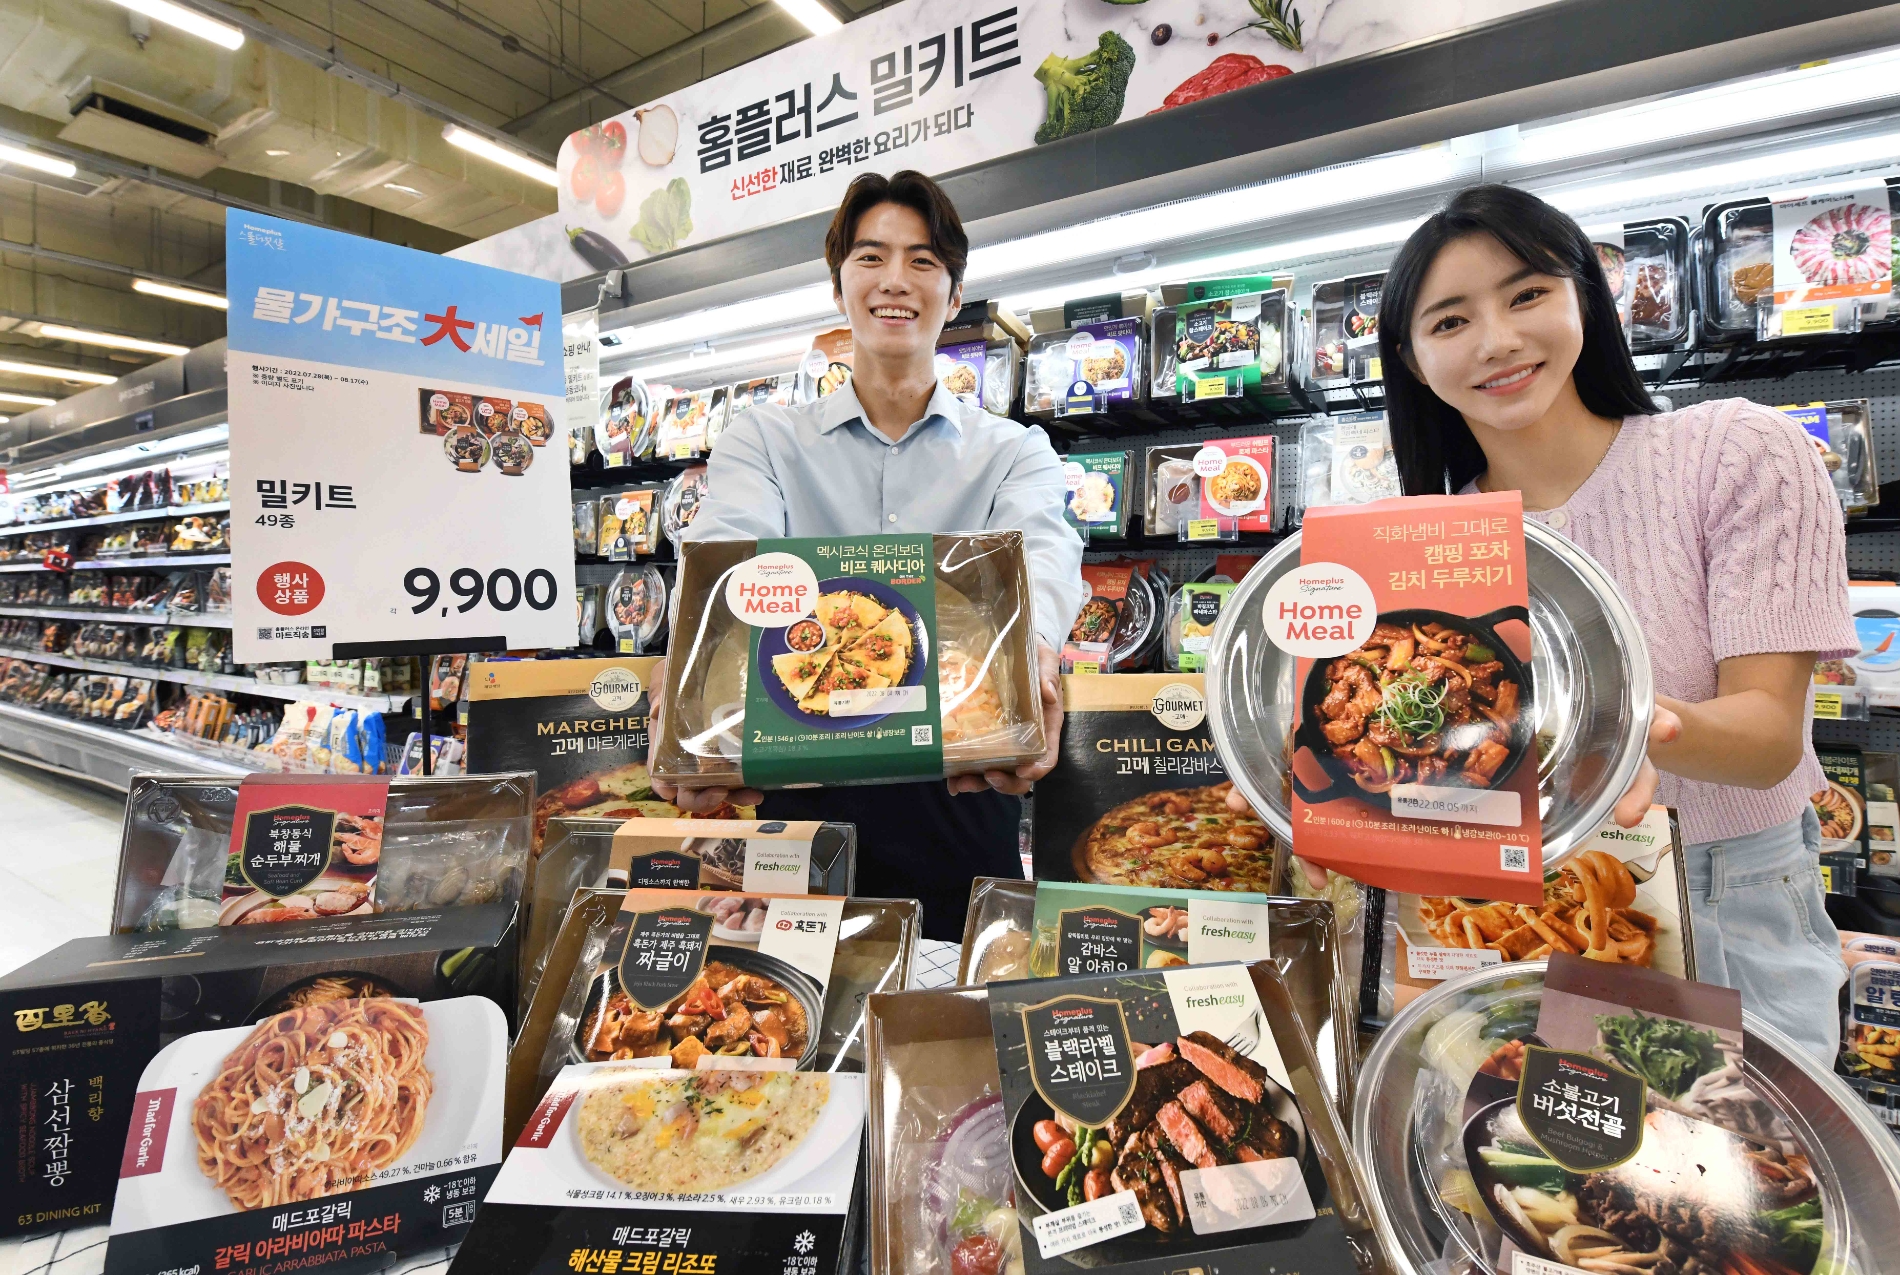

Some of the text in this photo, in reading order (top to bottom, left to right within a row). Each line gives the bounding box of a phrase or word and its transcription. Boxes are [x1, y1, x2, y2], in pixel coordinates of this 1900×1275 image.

[696, 6, 1021, 174] 홈플러스 밀키트
[730, 104, 973, 200] 신선한 완벽한 요리가 되다
[244, 223, 282, 236] Homeplus
[256, 479, 356, 510] 밀키트
[255, 514, 296, 528] 49종
[1373, 517, 1510, 543] 직화냄비 그대로
[817, 543, 924, 558] 멕시코식 온더보더
[1424, 540, 1511, 564] 캠핑 포차
[840, 559, 926, 575] 비프 퀘사디아
[274, 573, 309, 589] 행사
[1299, 577, 1344, 585] Homeplus
[1388, 565, 1512, 591] 김치 두루치기
[274, 589, 309, 605] 상품
[403, 567, 558, 617] 9,900
[739, 582, 808, 597] Home
[1300, 583, 1344, 595] Signature
[744, 597, 801, 614] Meal
[1279, 601, 1362, 620] Home
[275, 631, 310, 640] 마트직송
[1286, 621, 1355, 641] Meal
[591, 682, 640, 697] GOURMET
[1153, 698, 1203, 714] GOURMET
[753, 730, 773, 743] 2인분
[819, 732, 831, 741] 조리
[835, 732, 847, 740] 조리
[848, 731, 865, 739] 난이도
[551, 736, 584, 756] 고메
[1096, 738, 1160, 753] CHILI
[1116, 757, 1224, 775] 고메 칠리감바스
[1303, 809, 1439, 835] 2인분 600 10분 조리 조리 난이도
[269, 828, 313, 840] 북창동식
[273, 840, 302, 853] 해물
[250, 852, 321, 868] 순두부찌개
[754, 861, 801, 875] fresheasy
[638, 878, 671, 886] 디핑소스까지
[1083, 915, 1118, 925] Homeplus
[1202, 914, 1240, 924] Collaboration
[1201, 925, 1256, 943] fresheasy
[633, 938, 657, 949] 흑돈가
[660, 940, 676, 950] 제주
[1081, 942, 1118, 958] 감바스
[636, 950, 690, 972] 짜글이
[1067, 957, 1082, 974] 알
[1183, 983, 1224, 992] Collaboration
[1186, 993, 1245, 1009] fresheasy
[1052, 1007, 1093, 1018] Homeplus
[1043, 1027, 1081, 1038] 스테이크부터
[1096, 1024, 1109, 1032] 있는
[1044, 1035, 1117, 1062] 블랙라벨
[1050, 1058, 1122, 1083] 스테이크
[1558, 1058, 1608, 1078] Homeplus
[1558, 1063, 1608, 1082] Signature
[88, 1075, 104, 1122] 백리향
[1542, 1078, 1619, 1114] 소불고기
[1533, 1094, 1626, 1139] 버섯전골
[43, 1078, 75, 1187] 삼선짬뽕
[531, 1117, 550, 1142] Garlic
[1540, 1133, 1580, 1153] Mushroom
[1547, 1127, 1598, 1150] Beef Bulgogi
[379, 1168, 401, 1179] 49.27
[413, 1162, 436, 1174] 건마늘
[436, 1158, 453, 1169] 0.66
[462, 1154, 477, 1164] 함유
[446, 1186, 476, 1199] 냉동 보관
[566, 1190, 604, 1200] 식물성크림
[658, 1192, 665, 1200] 3
[677, 1193, 701, 1203] 위소라
[702, 1194, 715, 1203] 2.5
[729, 1195, 745, 1205] 새우
[746, 1195, 765, 1205] 2.93
[778, 1195, 802, 1205] 유크림
[803, 1196, 822, 1205] 0.18
[18, 1203, 102, 1226] 63 DINING KIT
[272, 1201, 352, 1232] 매드포갈릭
[448, 1207, 464, 1219] 5분
[214, 1212, 402, 1269] 갈릭 아라비아따 파스타
[613, 1227, 692, 1249] 매드포갈릭
[274, 1241, 386, 1272] ARRABBIATA PASTA
[569, 1248, 718, 1275] 해산물 크림 리조또
